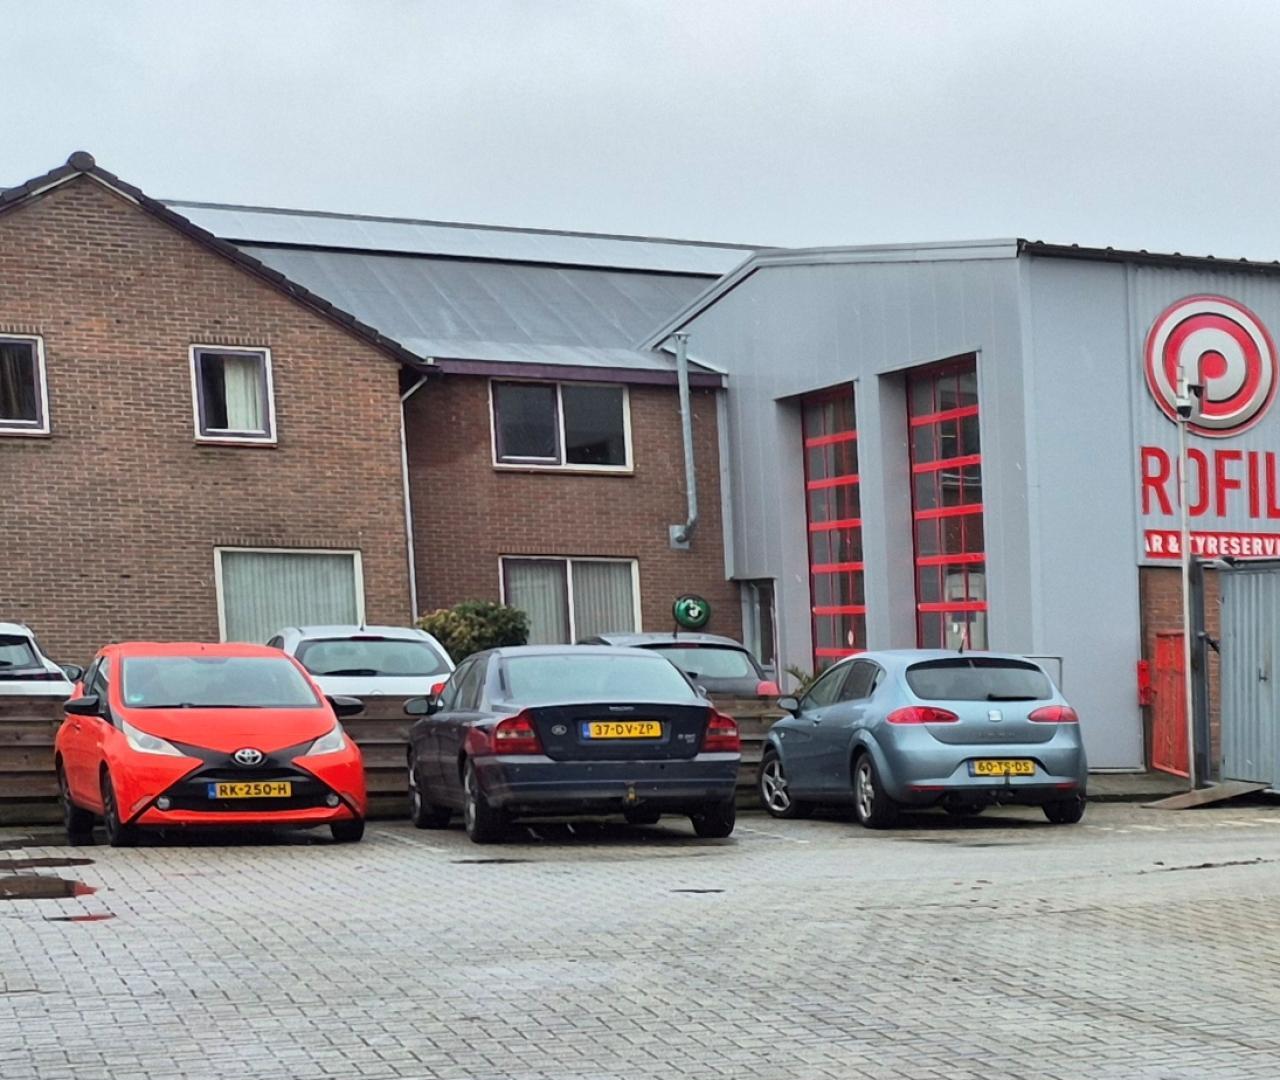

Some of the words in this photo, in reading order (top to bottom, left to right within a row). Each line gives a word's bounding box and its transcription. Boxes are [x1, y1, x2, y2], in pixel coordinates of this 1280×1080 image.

[1167, 534, 1181, 554] &
[594, 723, 654, 735] 37-DV-ZP
[219, 783, 288, 796] RK-250-H
